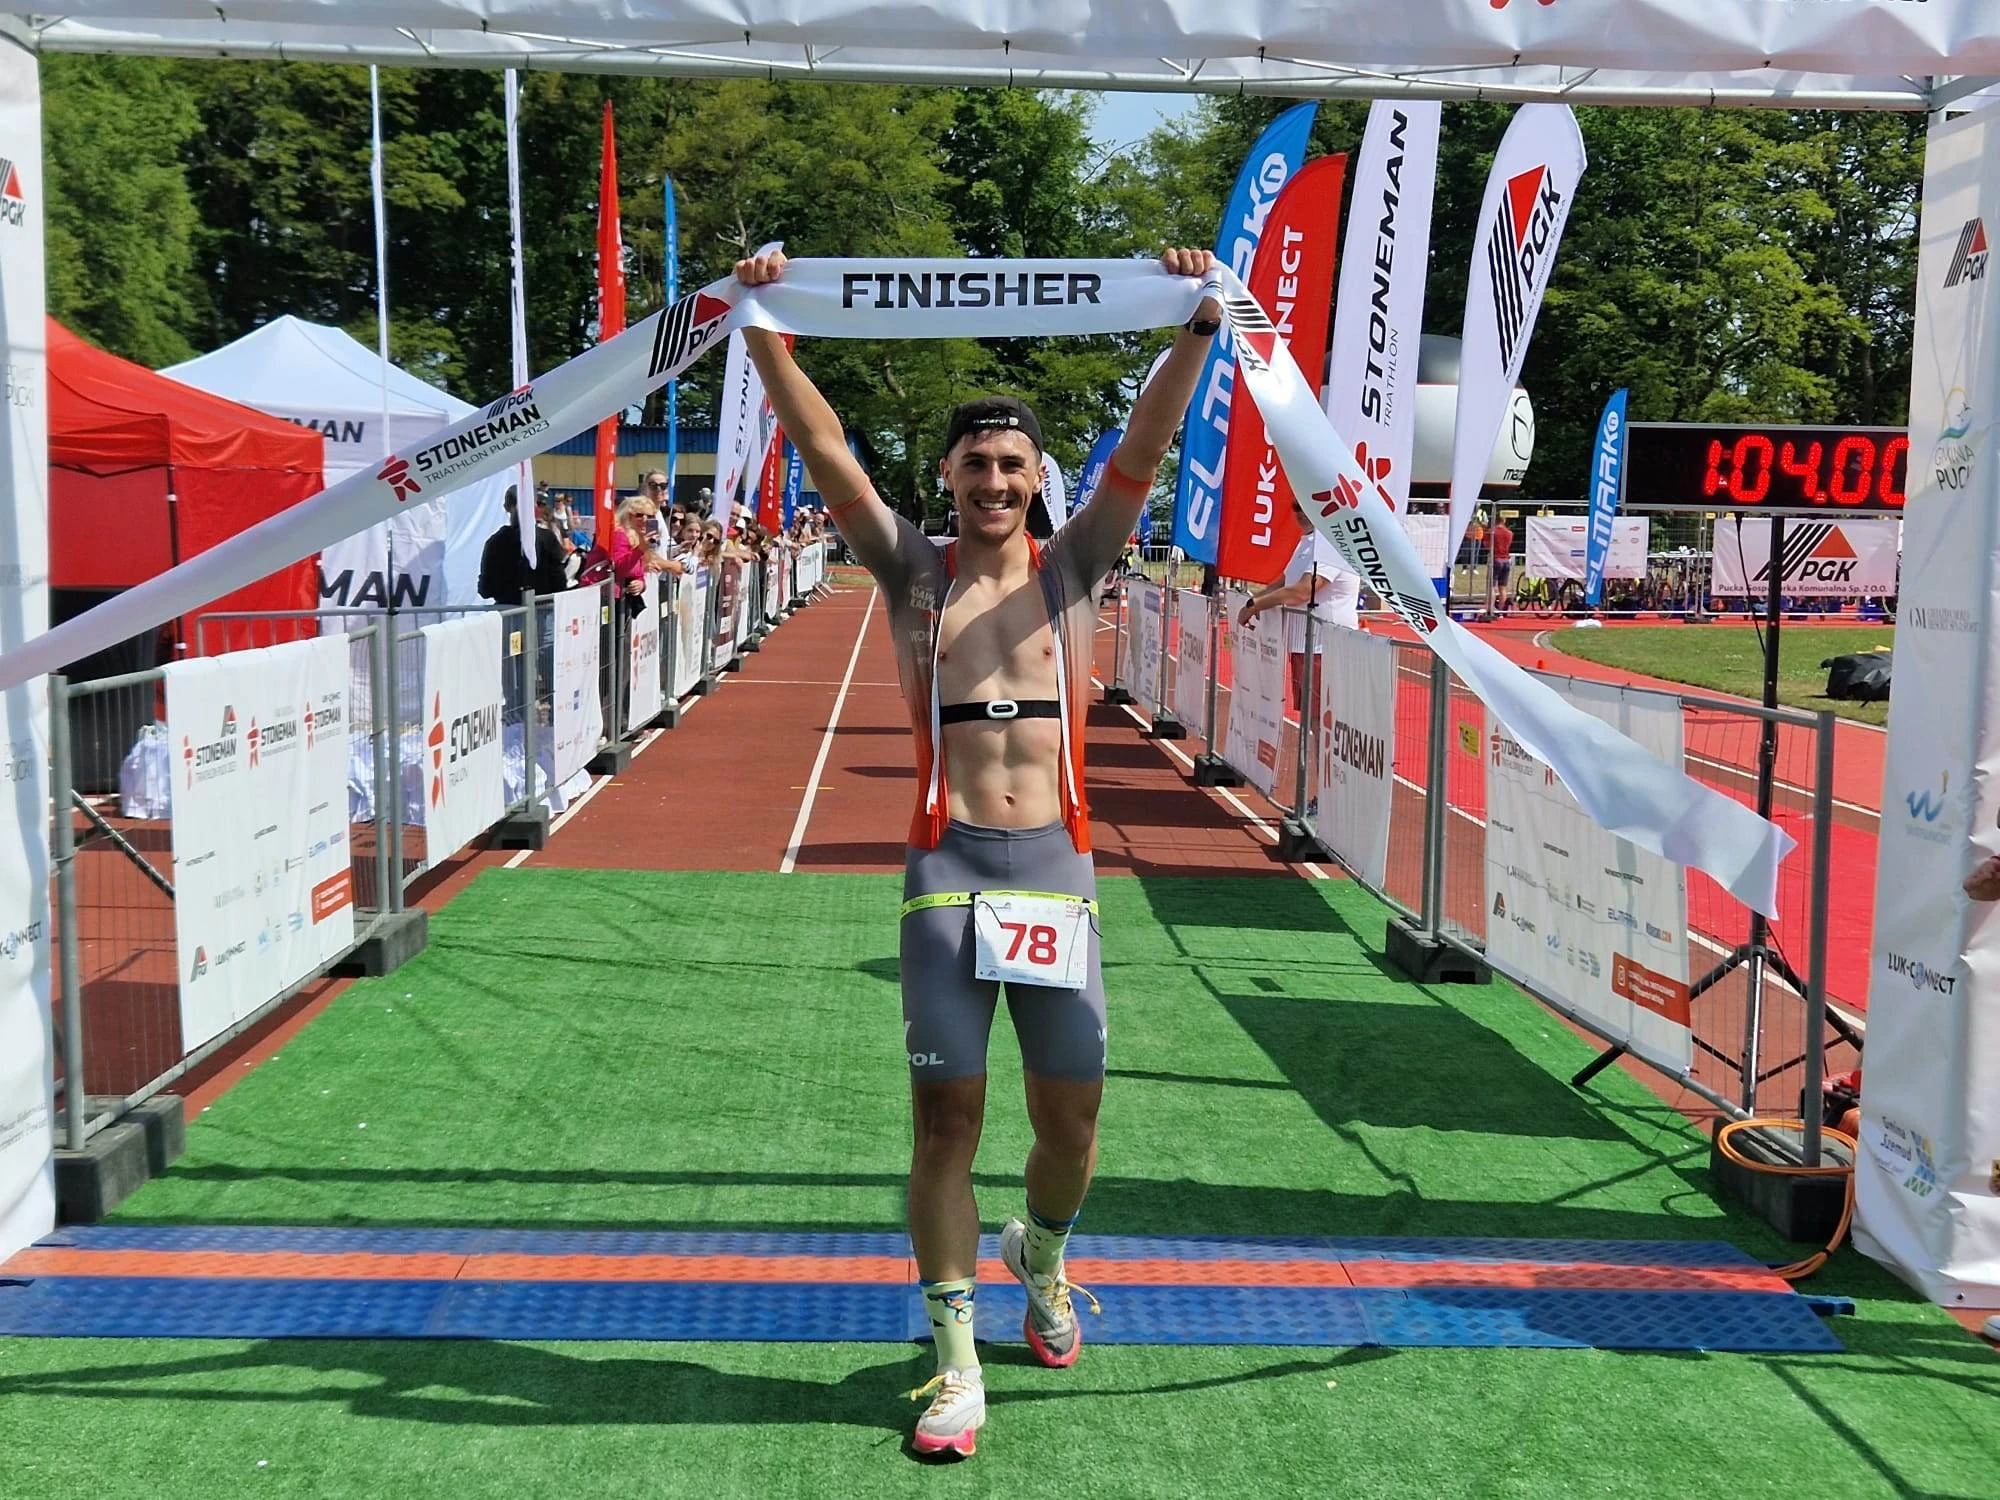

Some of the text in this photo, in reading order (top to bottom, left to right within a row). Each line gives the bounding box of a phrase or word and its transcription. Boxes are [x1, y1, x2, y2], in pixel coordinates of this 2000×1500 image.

[1519, 167, 1561, 292] PGK
[1361, 109, 1408, 424] STONEMAN
[1962, 252, 1989, 284] PGK
[843, 272, 1102, 309] FINISHER
[1383, 328, 1399, 428] TRIATHLON
[415, 404, 541, 472] STONEMAN
[424, 421, 550, 484] TRIATHLON PUCK 2023
[1799, 561, 1858, 581] PGK
[1799, 584, 1847, 592] Komunalna
[195, 738, 237, 767] STONEMAN
[1001, 922, 1057, 965] 78
